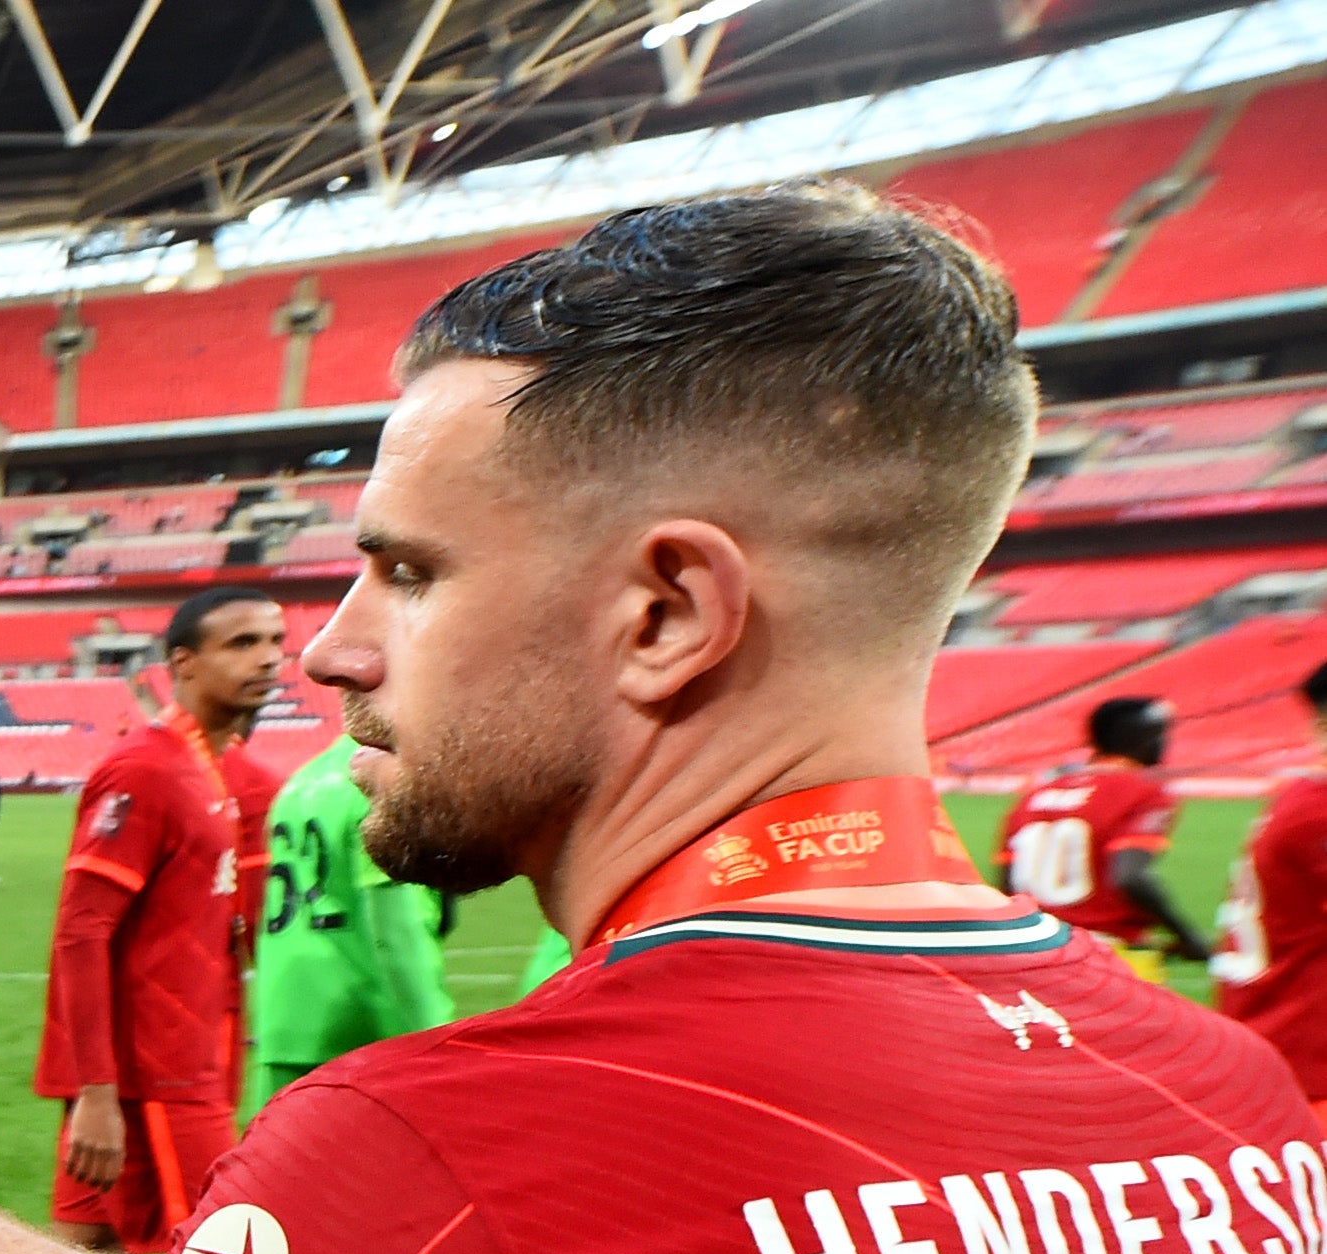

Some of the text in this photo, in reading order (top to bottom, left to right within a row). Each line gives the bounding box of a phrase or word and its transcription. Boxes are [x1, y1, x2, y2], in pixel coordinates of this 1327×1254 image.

[766, 810, 882, 842] Emirates
[776, 831, 885, 863] FA CUP
[1010, 818, 1093, 906] 10
